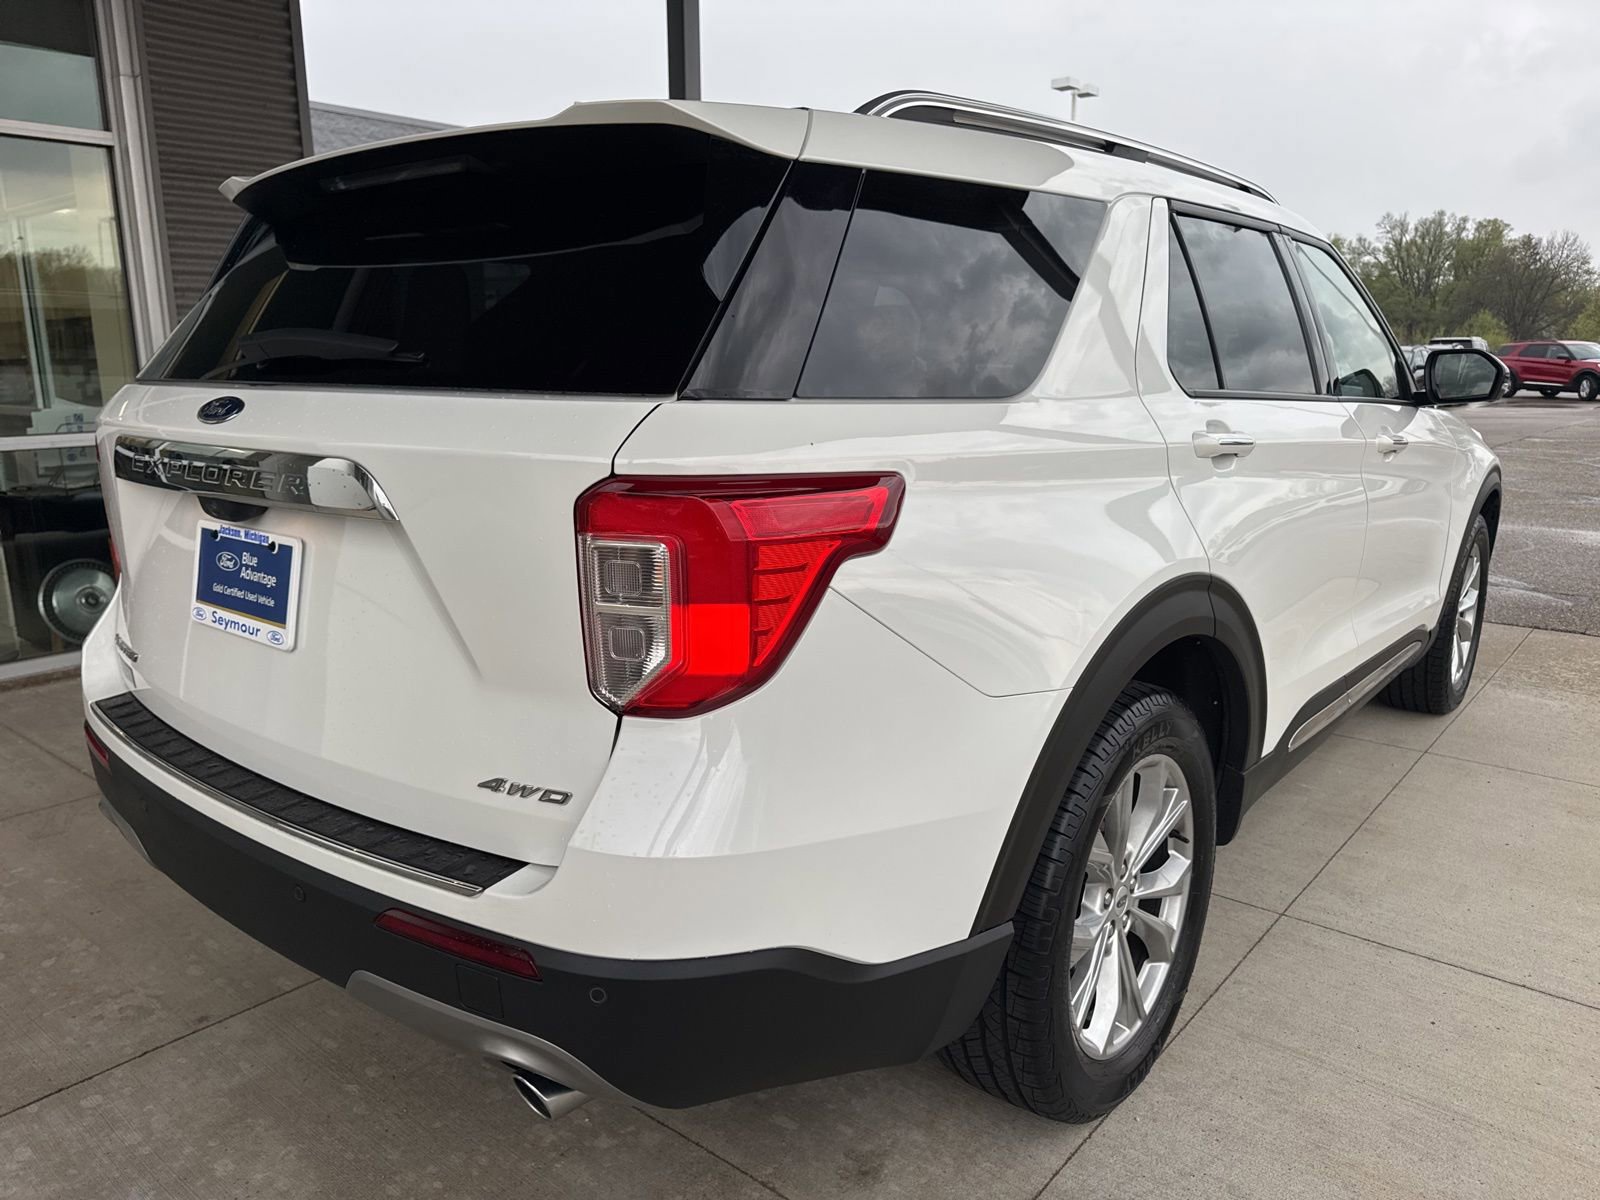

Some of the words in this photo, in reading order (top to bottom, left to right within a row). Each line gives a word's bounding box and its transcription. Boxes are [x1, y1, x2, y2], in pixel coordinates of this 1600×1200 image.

[131, 454, 304, 495] EXPLORER
[219, 525, 243, 538] Jackson,
[244, 529, 270, 544] Michigan
[220, 554, 236, 568] Ford
[241, 552, 258, 567] Blue
[240, 566, 277, 588] Advantage
[212, 583, 224, 592] Gold
[224, 584, 244, 598] Certified
[244, 589, 258, 602] Used
[257, 593, 275, 607] Vehicle
[211, 611, 261, 637] Seymour
[1132, 721, 1175, 760] KELLY
[477, 778, 573, 805] 4WD
